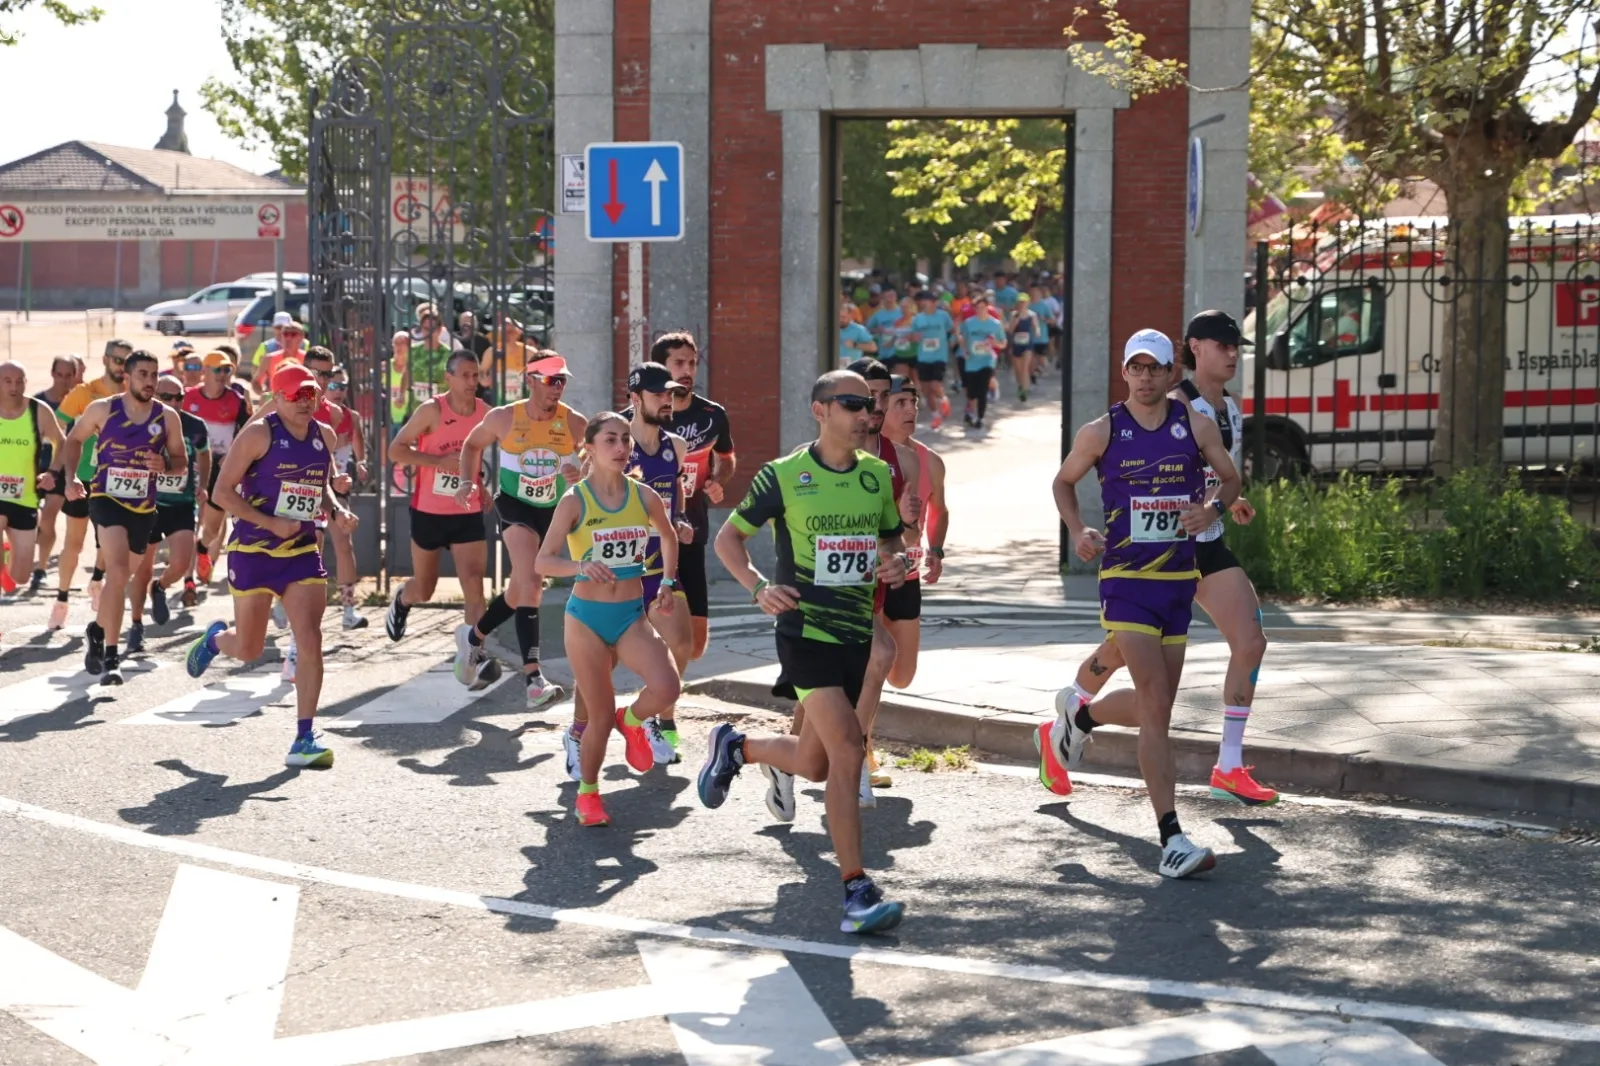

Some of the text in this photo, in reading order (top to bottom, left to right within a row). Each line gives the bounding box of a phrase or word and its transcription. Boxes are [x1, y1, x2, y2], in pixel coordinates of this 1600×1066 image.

[25, 205, 62, 214] ACCESO
[65, 205, 114, 214] PROHIBIDO
[117, 205, 123, 214] A
[126, 205, 149, 214] TODA
[152, 205, 194, 214] PERSONA
[197, 205, 202, 213] Y
[65, 217, 215, 226] EXCEPTO PERSONAL DEL CENTRO
[107, 228, 119, 237] SE
[121, 228, 146, 237] AVISA
[1422, 349, 1599, 375] Cr Española
[524, 458, 556, 467] ALCER
[1159, 464, 1184, 472] PRIM
[114, 477, 141, 491] 794
[158, 475, 182, 487] 957
[442, 475, 459, 489] 78
[521, 475, 556, 486] bedunia
[0, 483, 17, 494] 95
[525, 483, 553, 497] 887
[287, 495, 315, 512] 953
[1141, 511, 1181, 531] 787
[593, 529, 647, 542] bedunia
[602, 540, 637, 559] 831
[818, 538, 876, 551] bedunia
[827, 552, 868, 574] 878
